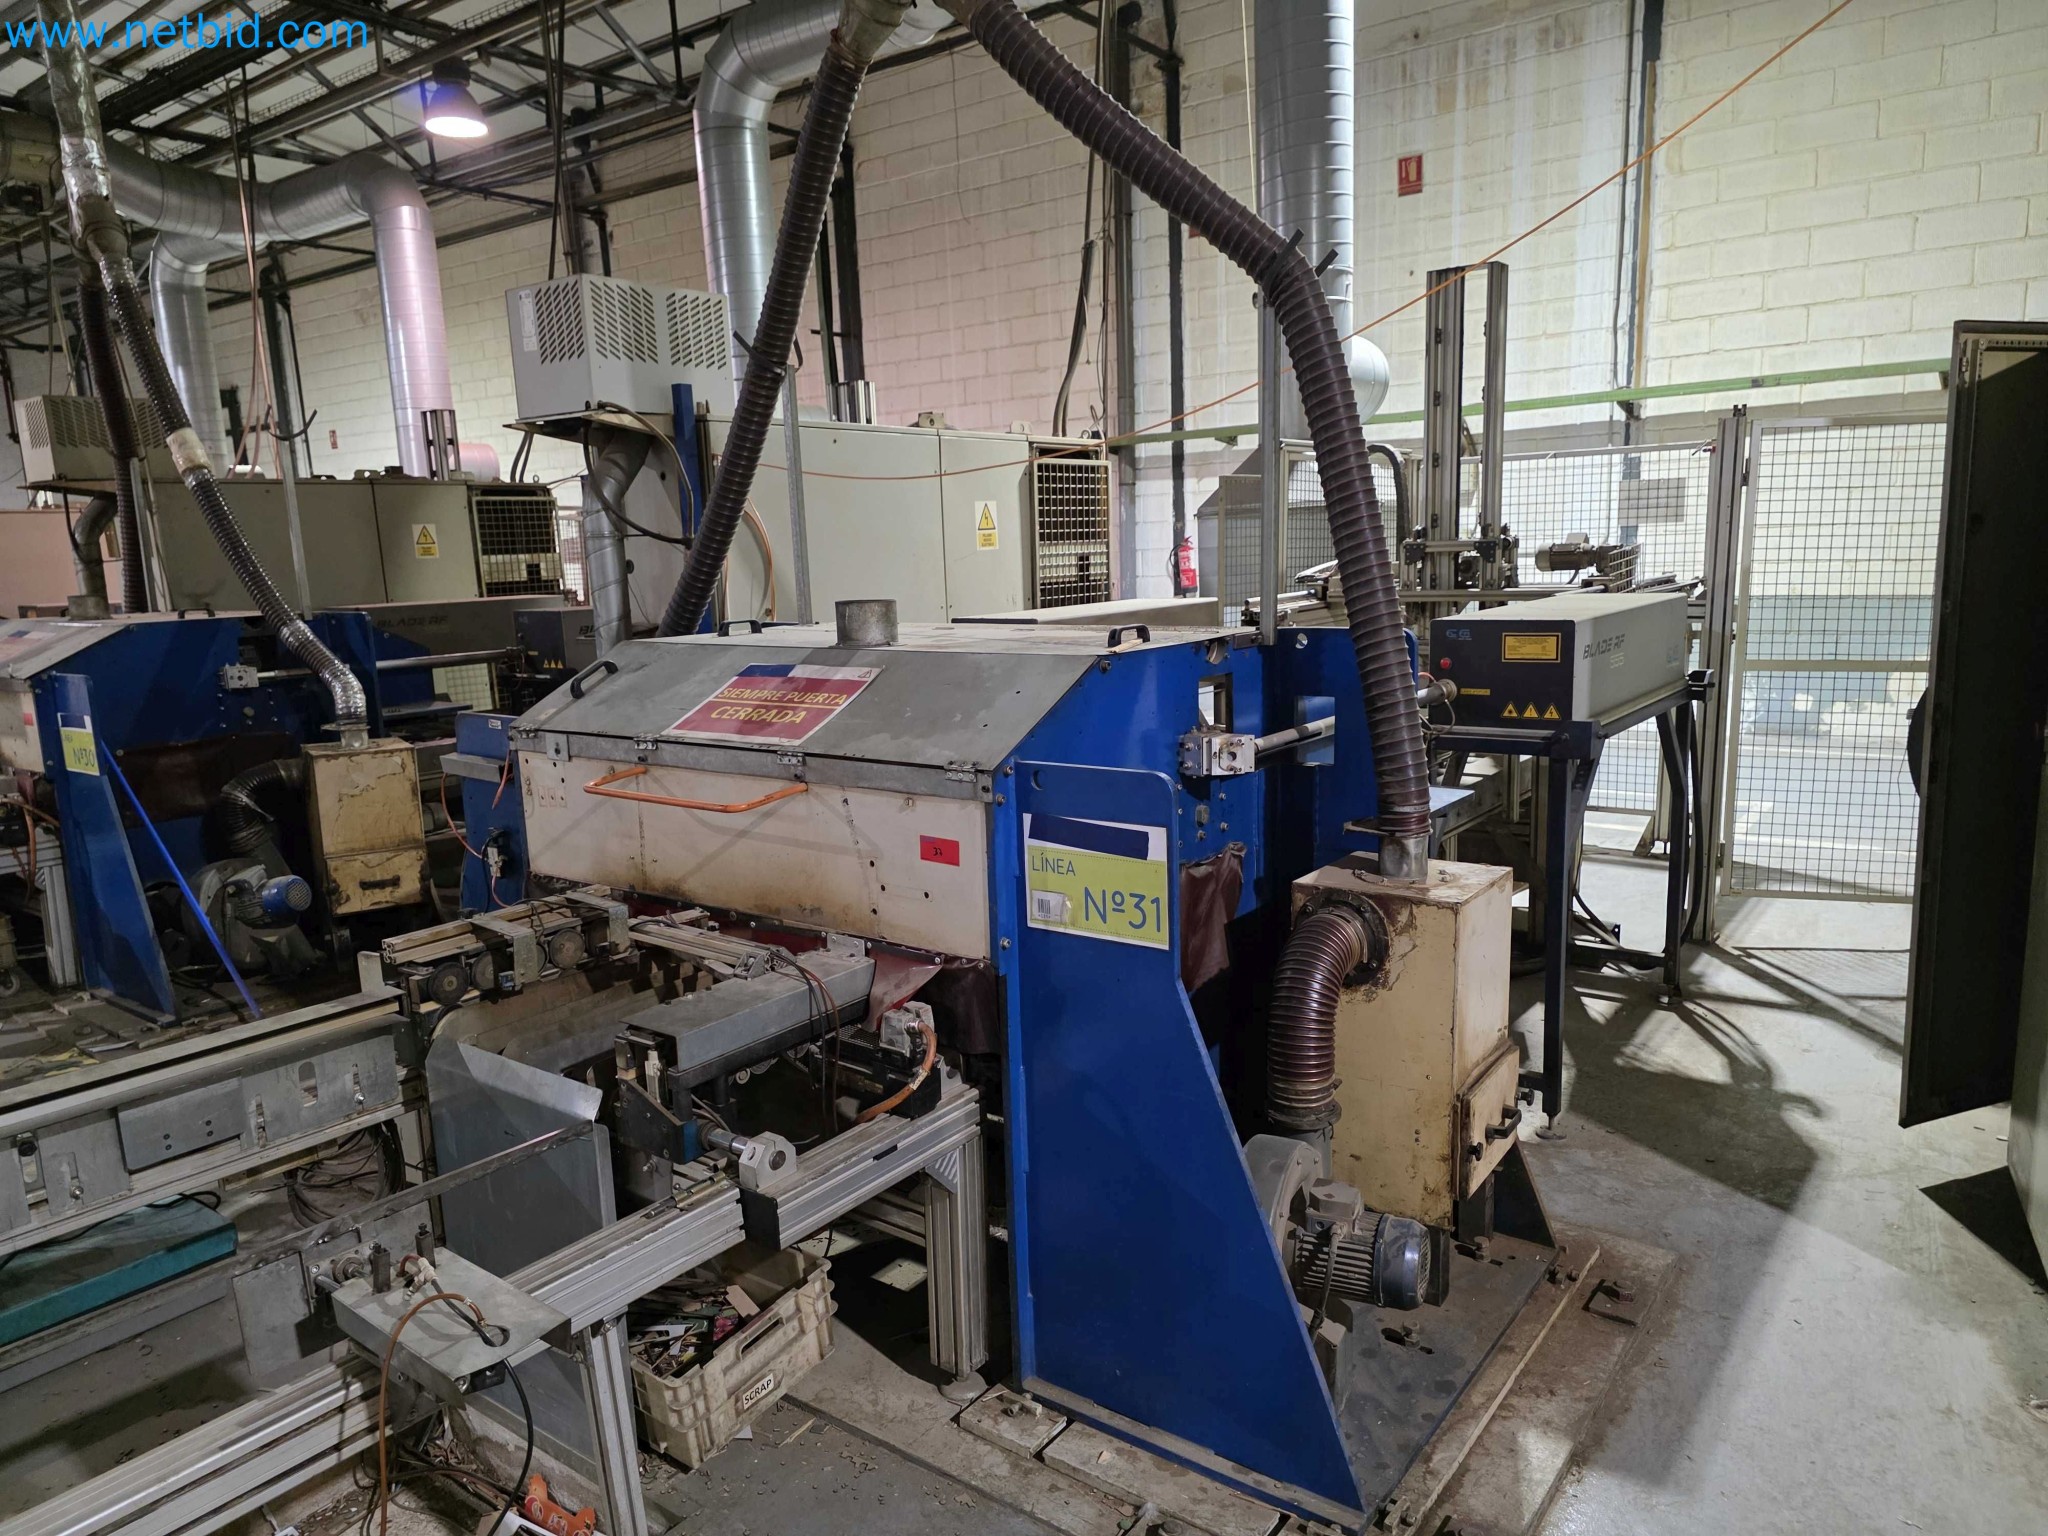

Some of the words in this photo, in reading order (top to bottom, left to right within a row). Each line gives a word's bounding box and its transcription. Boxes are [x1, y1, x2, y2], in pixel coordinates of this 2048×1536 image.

[1583, 637, 1613, 660] BLADE
[718, 687, 784, 701] SIEMPRE
[786, 691, 848, 705] PUERTA
[711, 706, 808, 724] CERRADA
[1032, 852, 1076, 876] LÍNEA
[1084, 886, 1161, 933] Nº31
[744, 1378, 772, 1405] SCRAP
